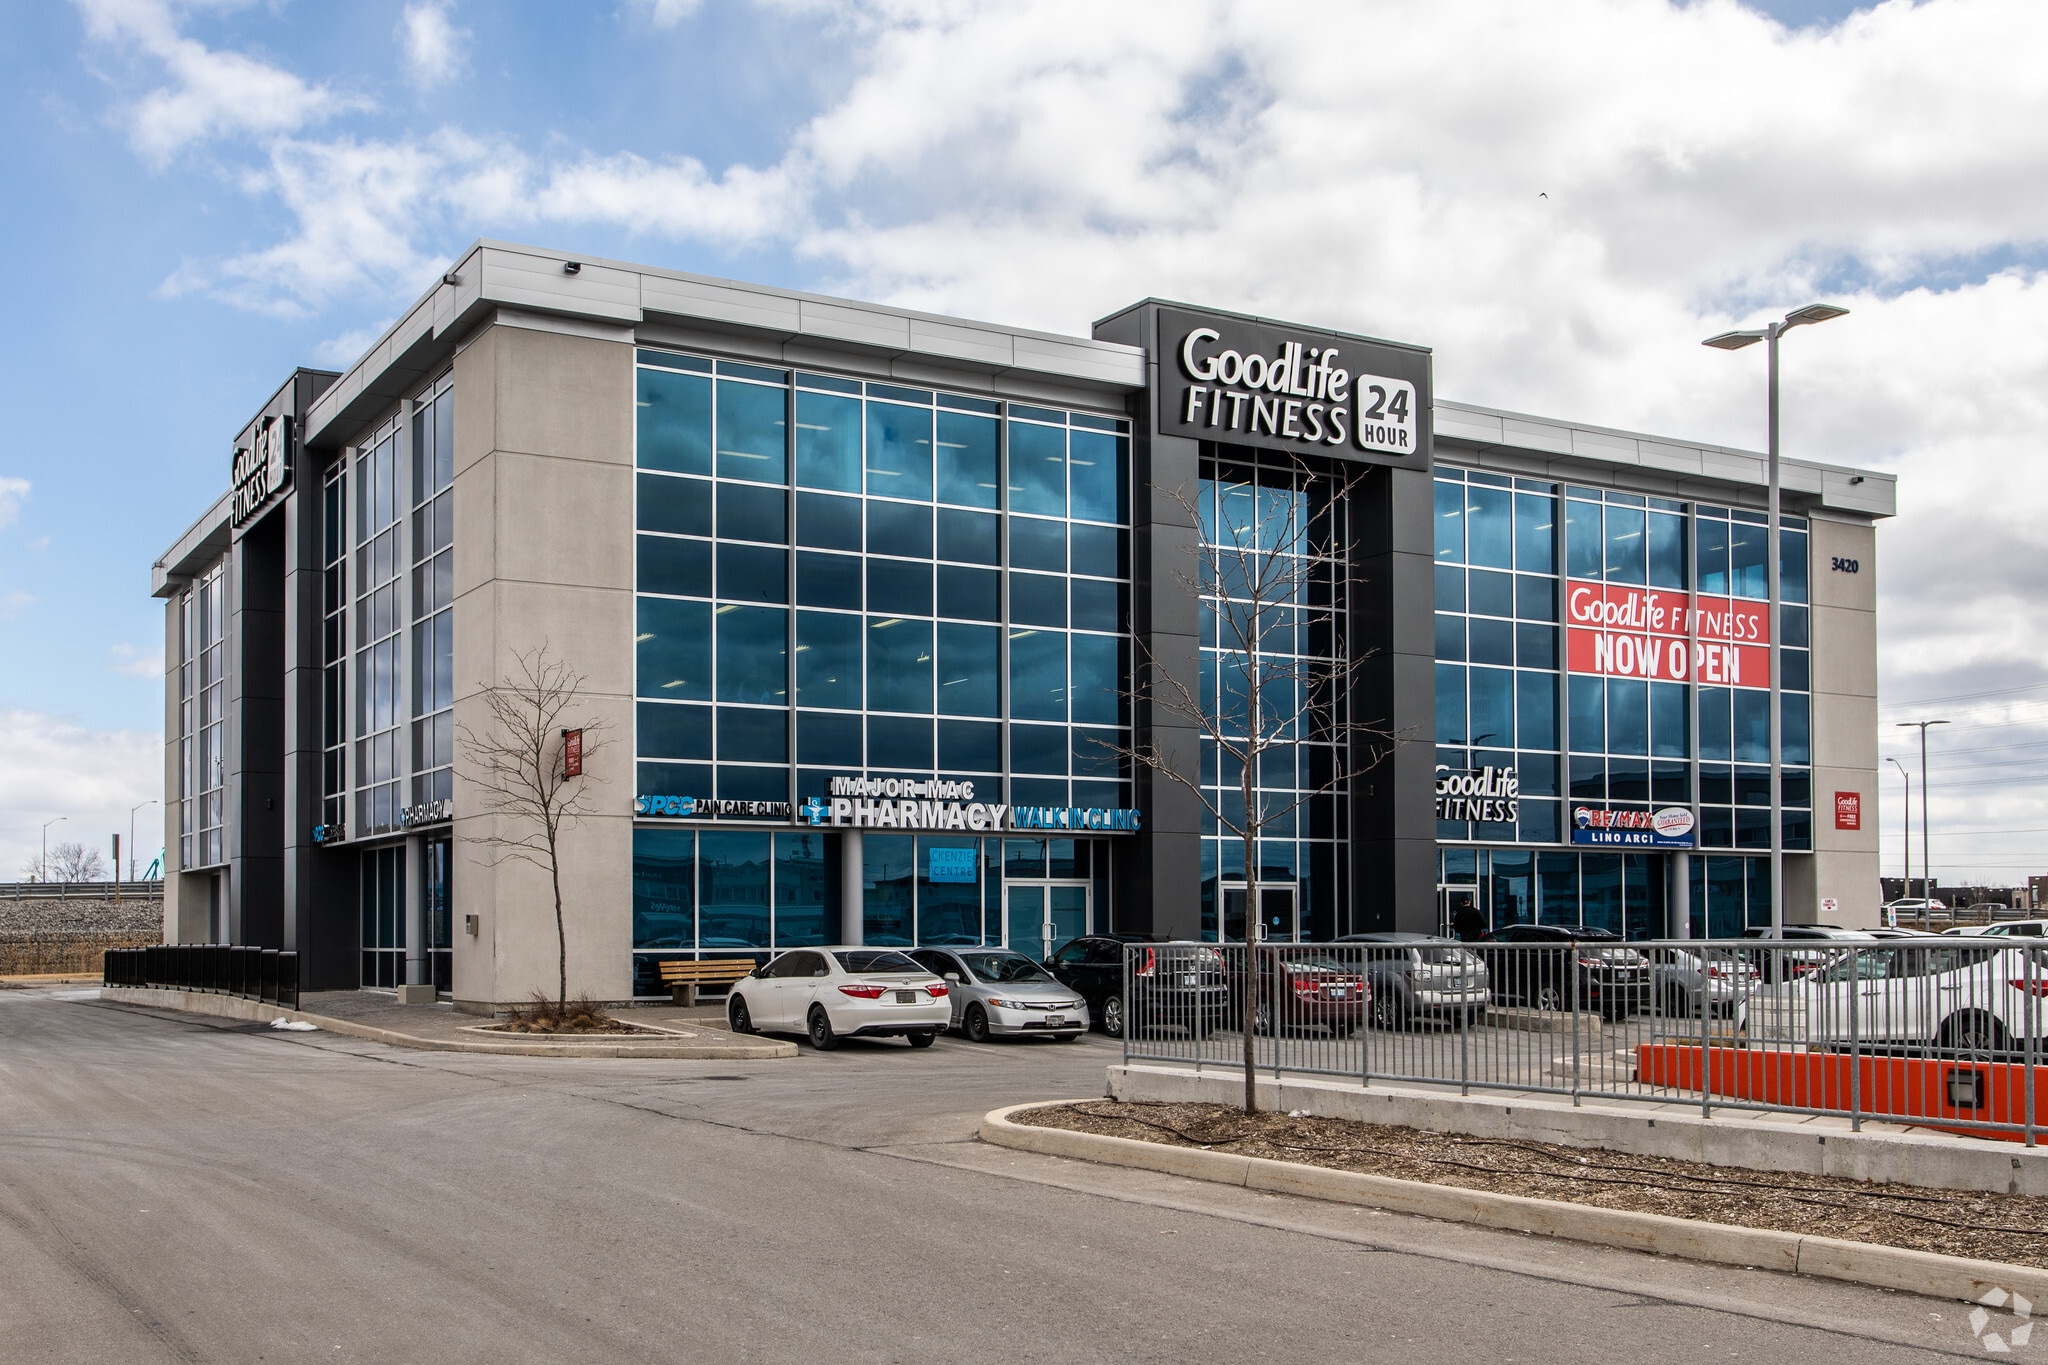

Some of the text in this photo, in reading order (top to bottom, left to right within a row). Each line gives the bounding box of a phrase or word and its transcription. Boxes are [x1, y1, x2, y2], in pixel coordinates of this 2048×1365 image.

[1183, 327, 1349, 402] GoodLife
[1186, 384, 1348, 445] FITNESS
[1364, 384, 1409, 424] 24
[1364, 423, 1408, 448] HOUR
[231, 415, 268, 492] GoodLife
[229, 465, 267, 529] FITNESS
[1831, 556, 1859, 574] 3420
[1570, 587, 1759, 640] GoodLife FITNESS
[1594, 633, 1740, 684] NOW OPEN
[832, 776, 975, 800] MAJOR MAC
[1436, 764, 1519, 798] GoodLife
[405, 799, 445, 827] PHARMACY
[636, 795, 694, 816] SPCC
[696, 800, 793, 817] PAIN CARE CLINIC
[1837, 796, 1858, 805] GoodLife
[1838, 804, 1858, 812] FITNESS
[832, 797, 1008, 831] PHARMACY
[1013, 806, 1142, 831] WALK IN CLINIC
[1591, 810, 1653, 828] RE/MAX
[1591, 832, 1621, 843] LINO
[1624, 834, 1654, 844] ARCI
[933, 866, 973, 877] CENTRE
